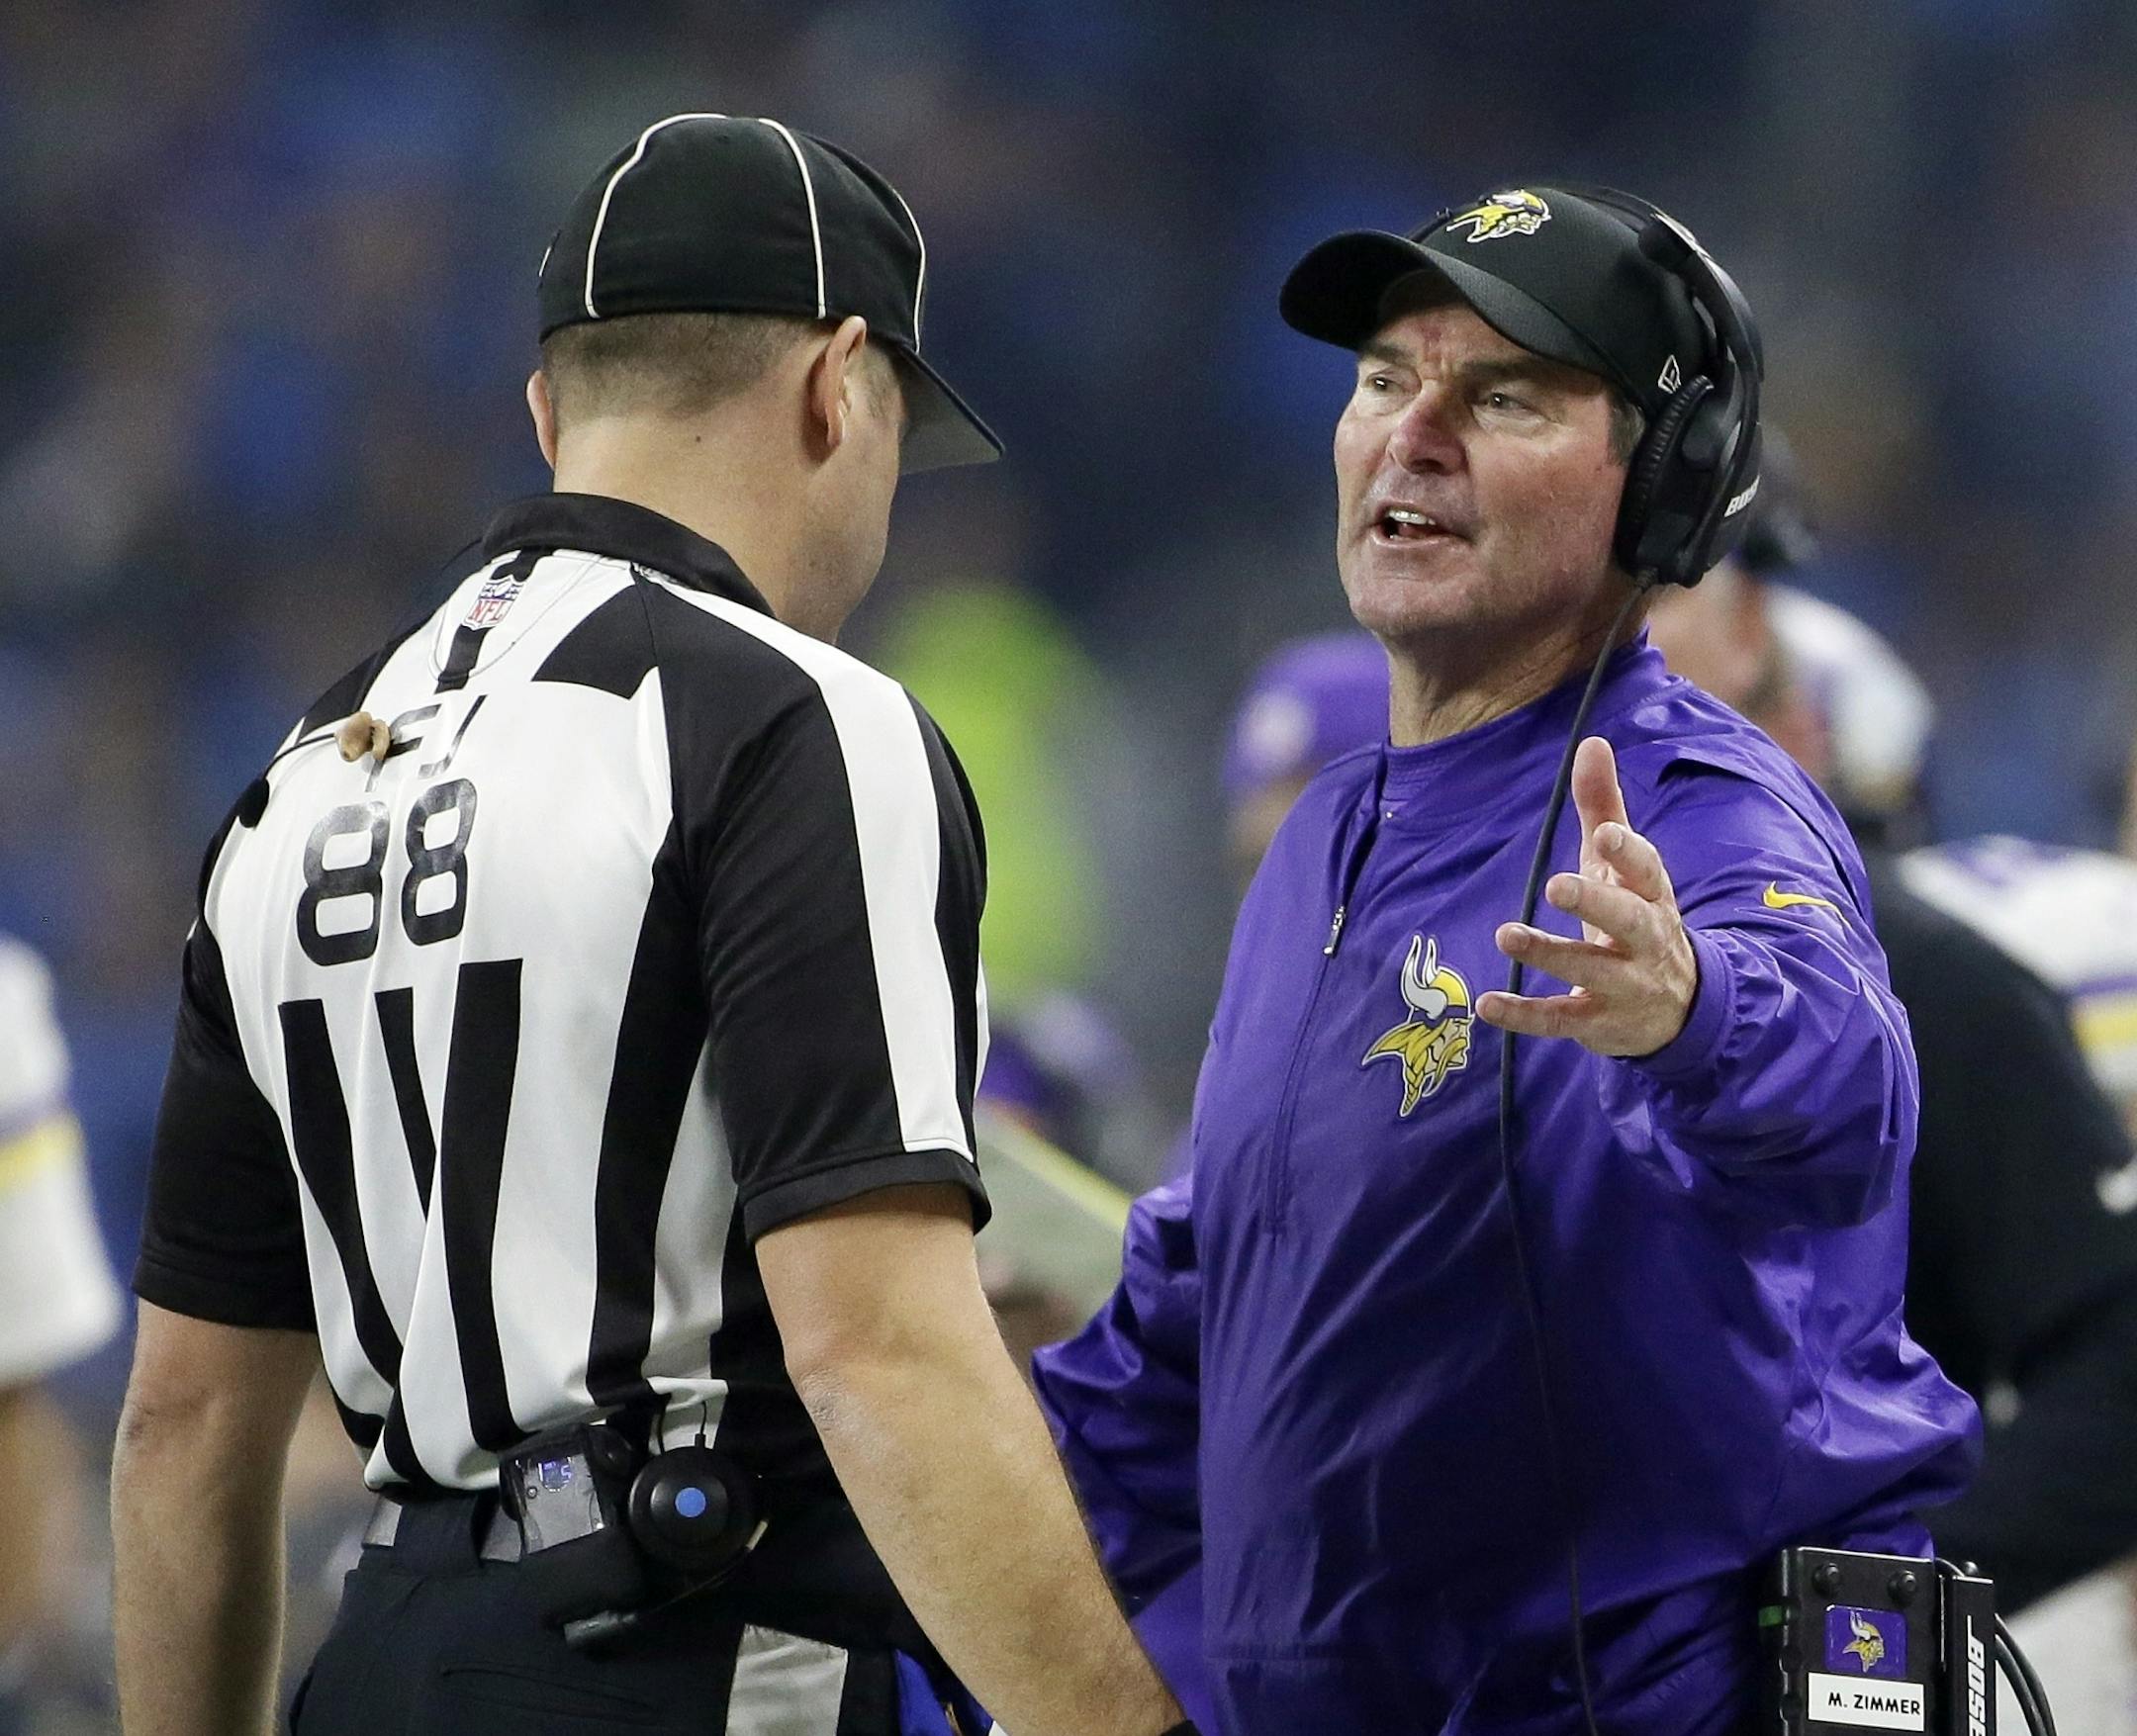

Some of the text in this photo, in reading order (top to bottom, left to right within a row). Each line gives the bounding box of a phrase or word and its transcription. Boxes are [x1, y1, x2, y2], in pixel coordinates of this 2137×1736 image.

[1723, 475, 1760, 517] BOS
[467, 599, 507, 623] NFL
[297, 777, 478, 967] 88
[1967, 1614, 1986, 1736] BOSE
[1828, 1692, 1921, 1715] M. ZIMMER
